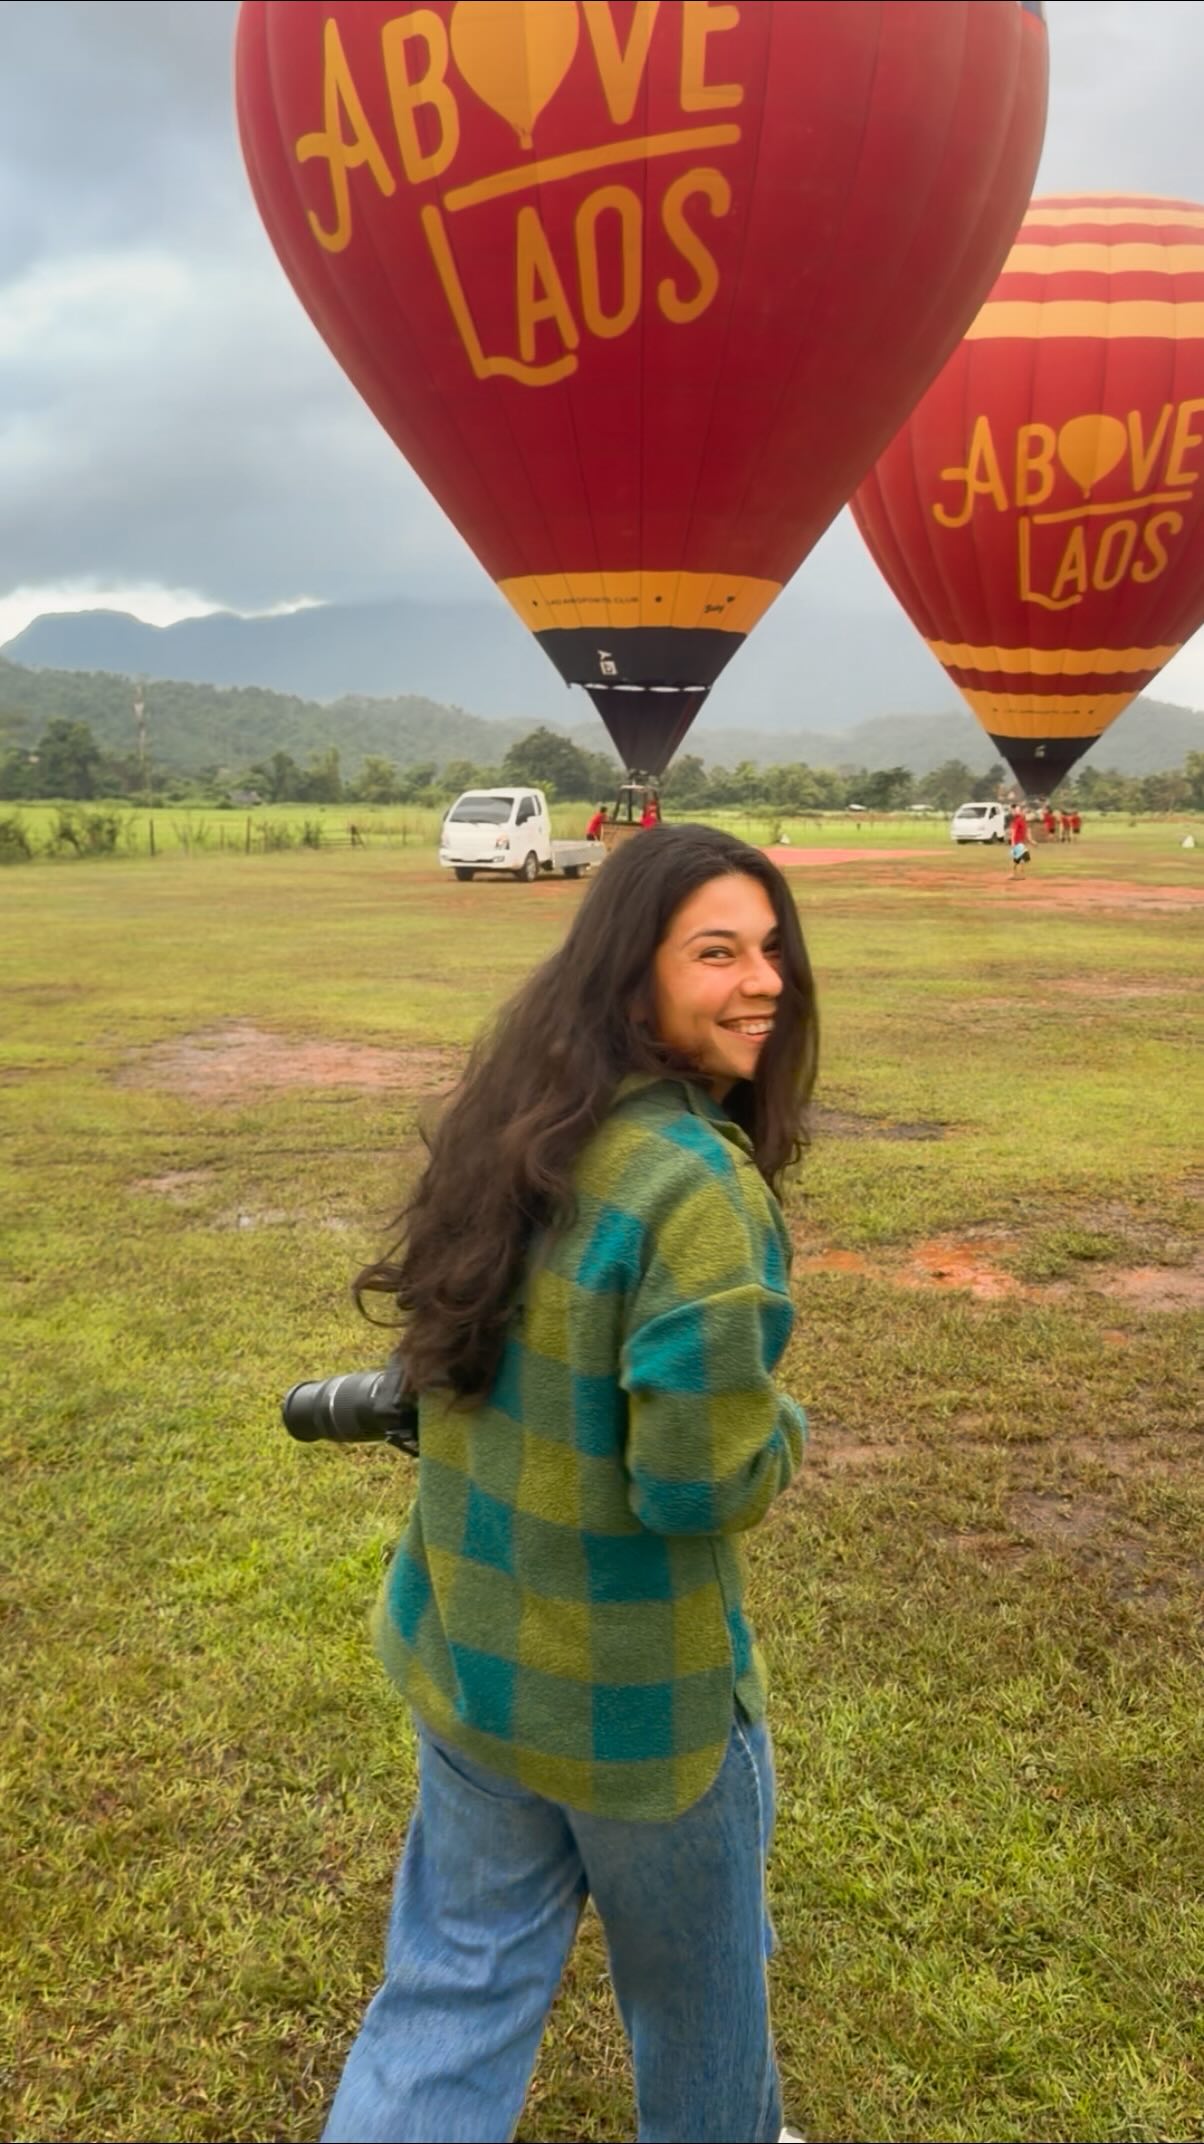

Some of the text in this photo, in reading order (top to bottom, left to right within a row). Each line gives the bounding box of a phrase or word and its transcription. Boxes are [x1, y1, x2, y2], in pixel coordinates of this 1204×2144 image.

[295, 1, 744, 253] ABOVE
[421, 168, 732, 386] LAOS
[933, 397, 1204, 528] ABOVE
[1018, 511, 1184, 611] LAOS
